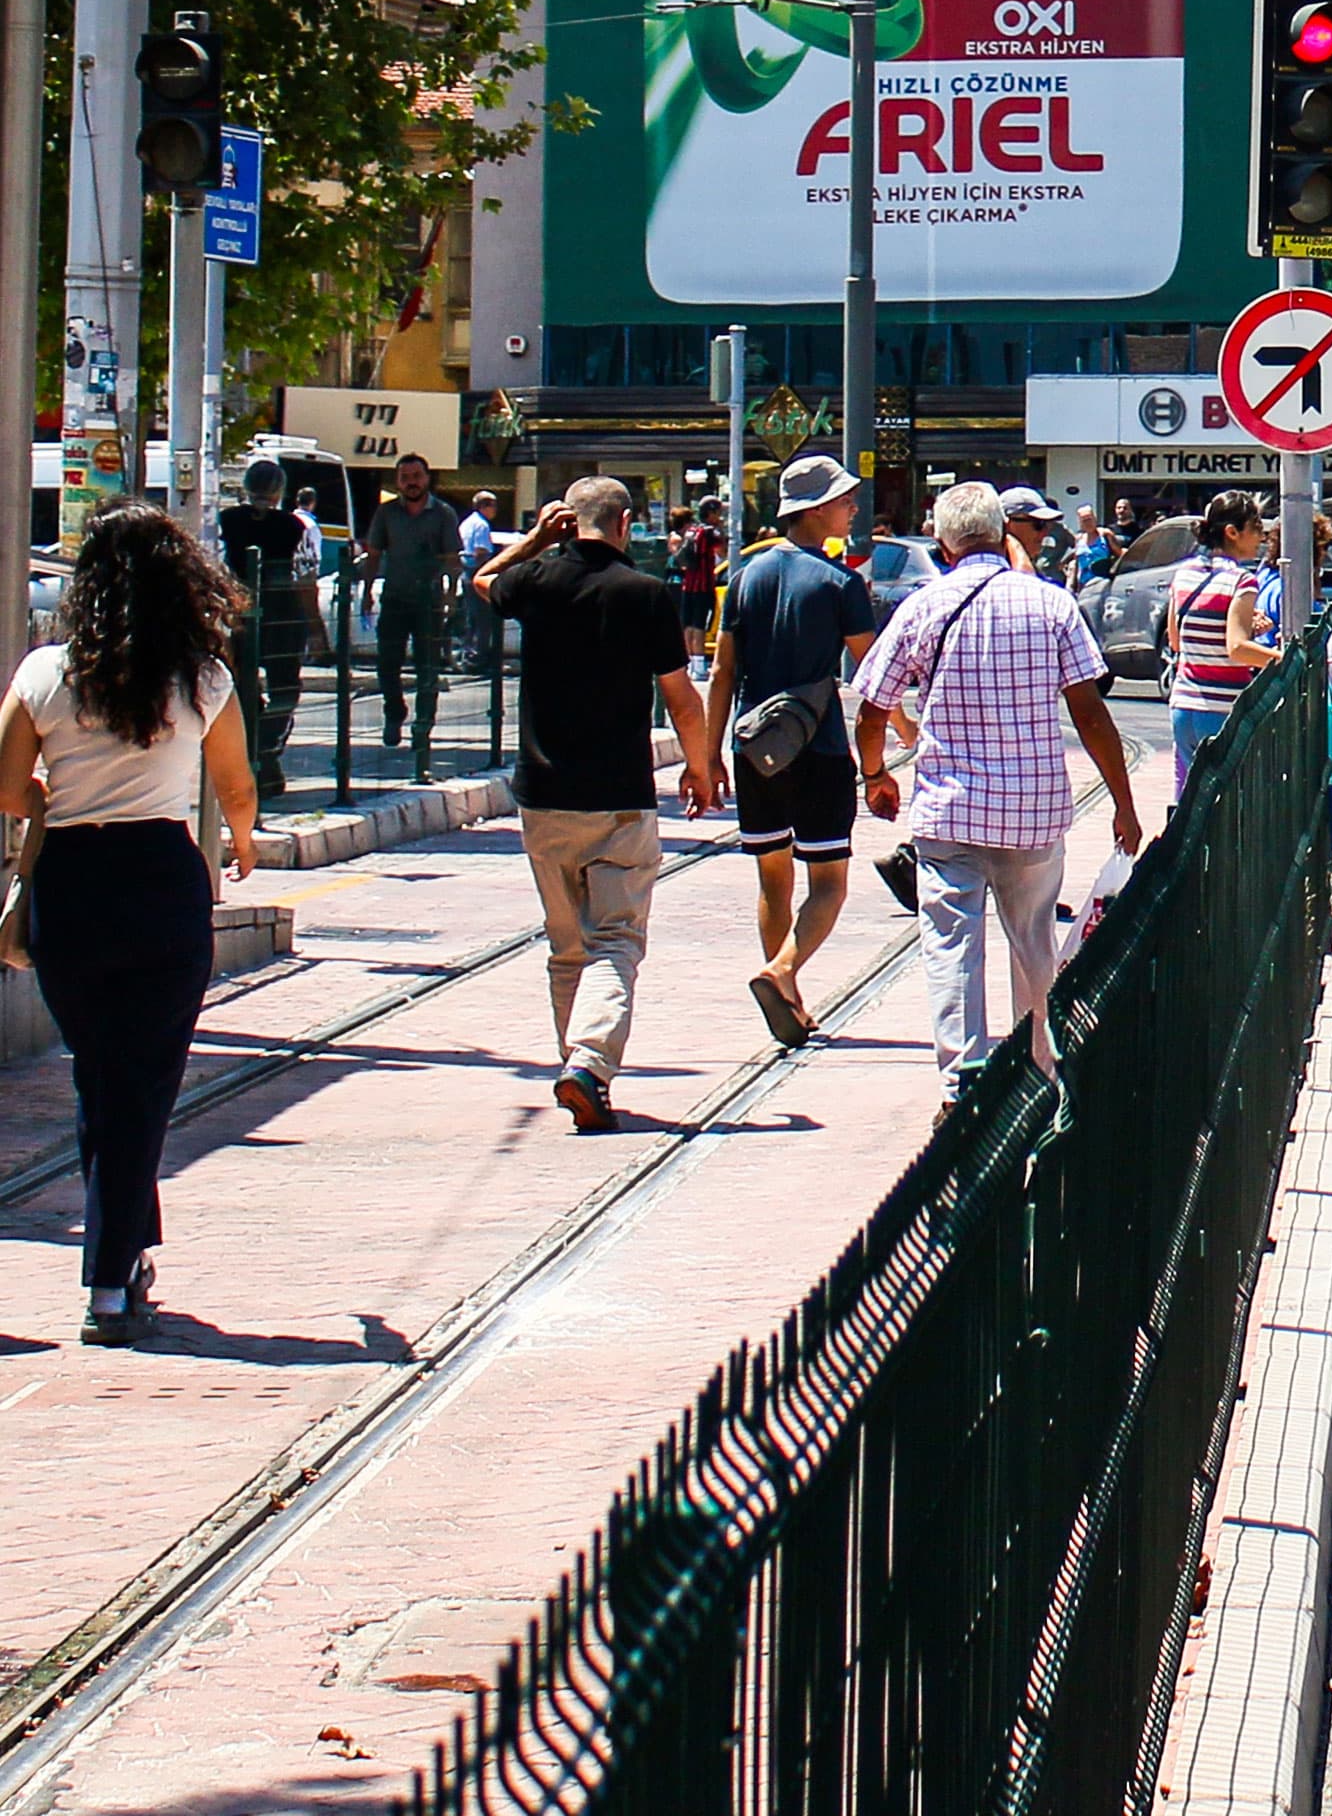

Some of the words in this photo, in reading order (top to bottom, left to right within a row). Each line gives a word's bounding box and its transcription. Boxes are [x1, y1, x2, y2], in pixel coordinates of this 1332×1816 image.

[994, 0, 1074, 36] OXI
[965, 41, 1033, 56] EKSTRA
[1040, 38, 1105, 54] HİJYEN
[878, 77, 940, 94] HIZLI
[950, 73, 1069, 96] ÇÖZÜNME
[796, 96, 1104, 177] ARIEL
[806, 187, 882, 203] EKSTA
[888, 183, 957, 201] HİJYEN
[963, 182, 1001, 202] İÇİN
[1008, 185, 1085, 200] EKSTRA
[1103, 450, 1157, 473] ÜMİT
[1162, 450, 1256, 473] TİCARET
